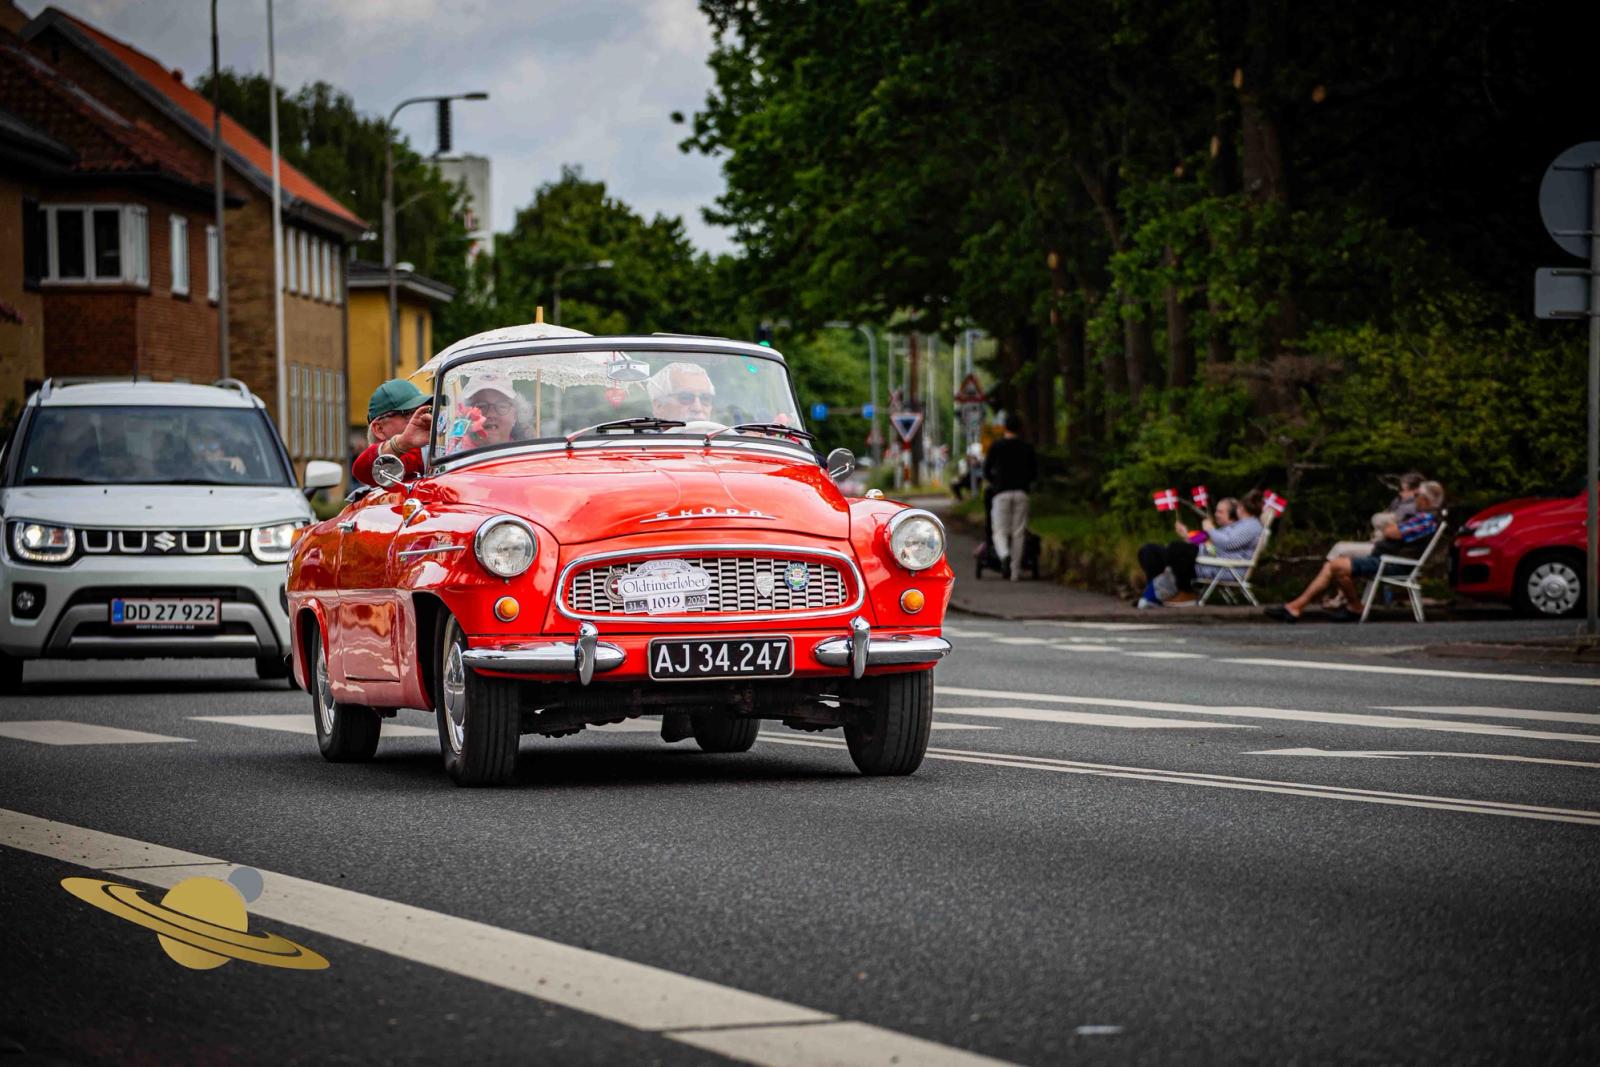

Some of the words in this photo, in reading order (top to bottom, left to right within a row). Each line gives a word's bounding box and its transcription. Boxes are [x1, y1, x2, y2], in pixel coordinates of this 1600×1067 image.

[623, 576, 706, 594] Oldtimerløbet
[652, 596, 680, 608] 1019
[687, 595, 706, 605] 2025
[125, 604, 151, 621] DD
[155, 604, 177, 621] 27
[182, 604, 215, 621] 922
[655, 644, 690, 673] AJ
[698, 642, 787, 672] 34.247
